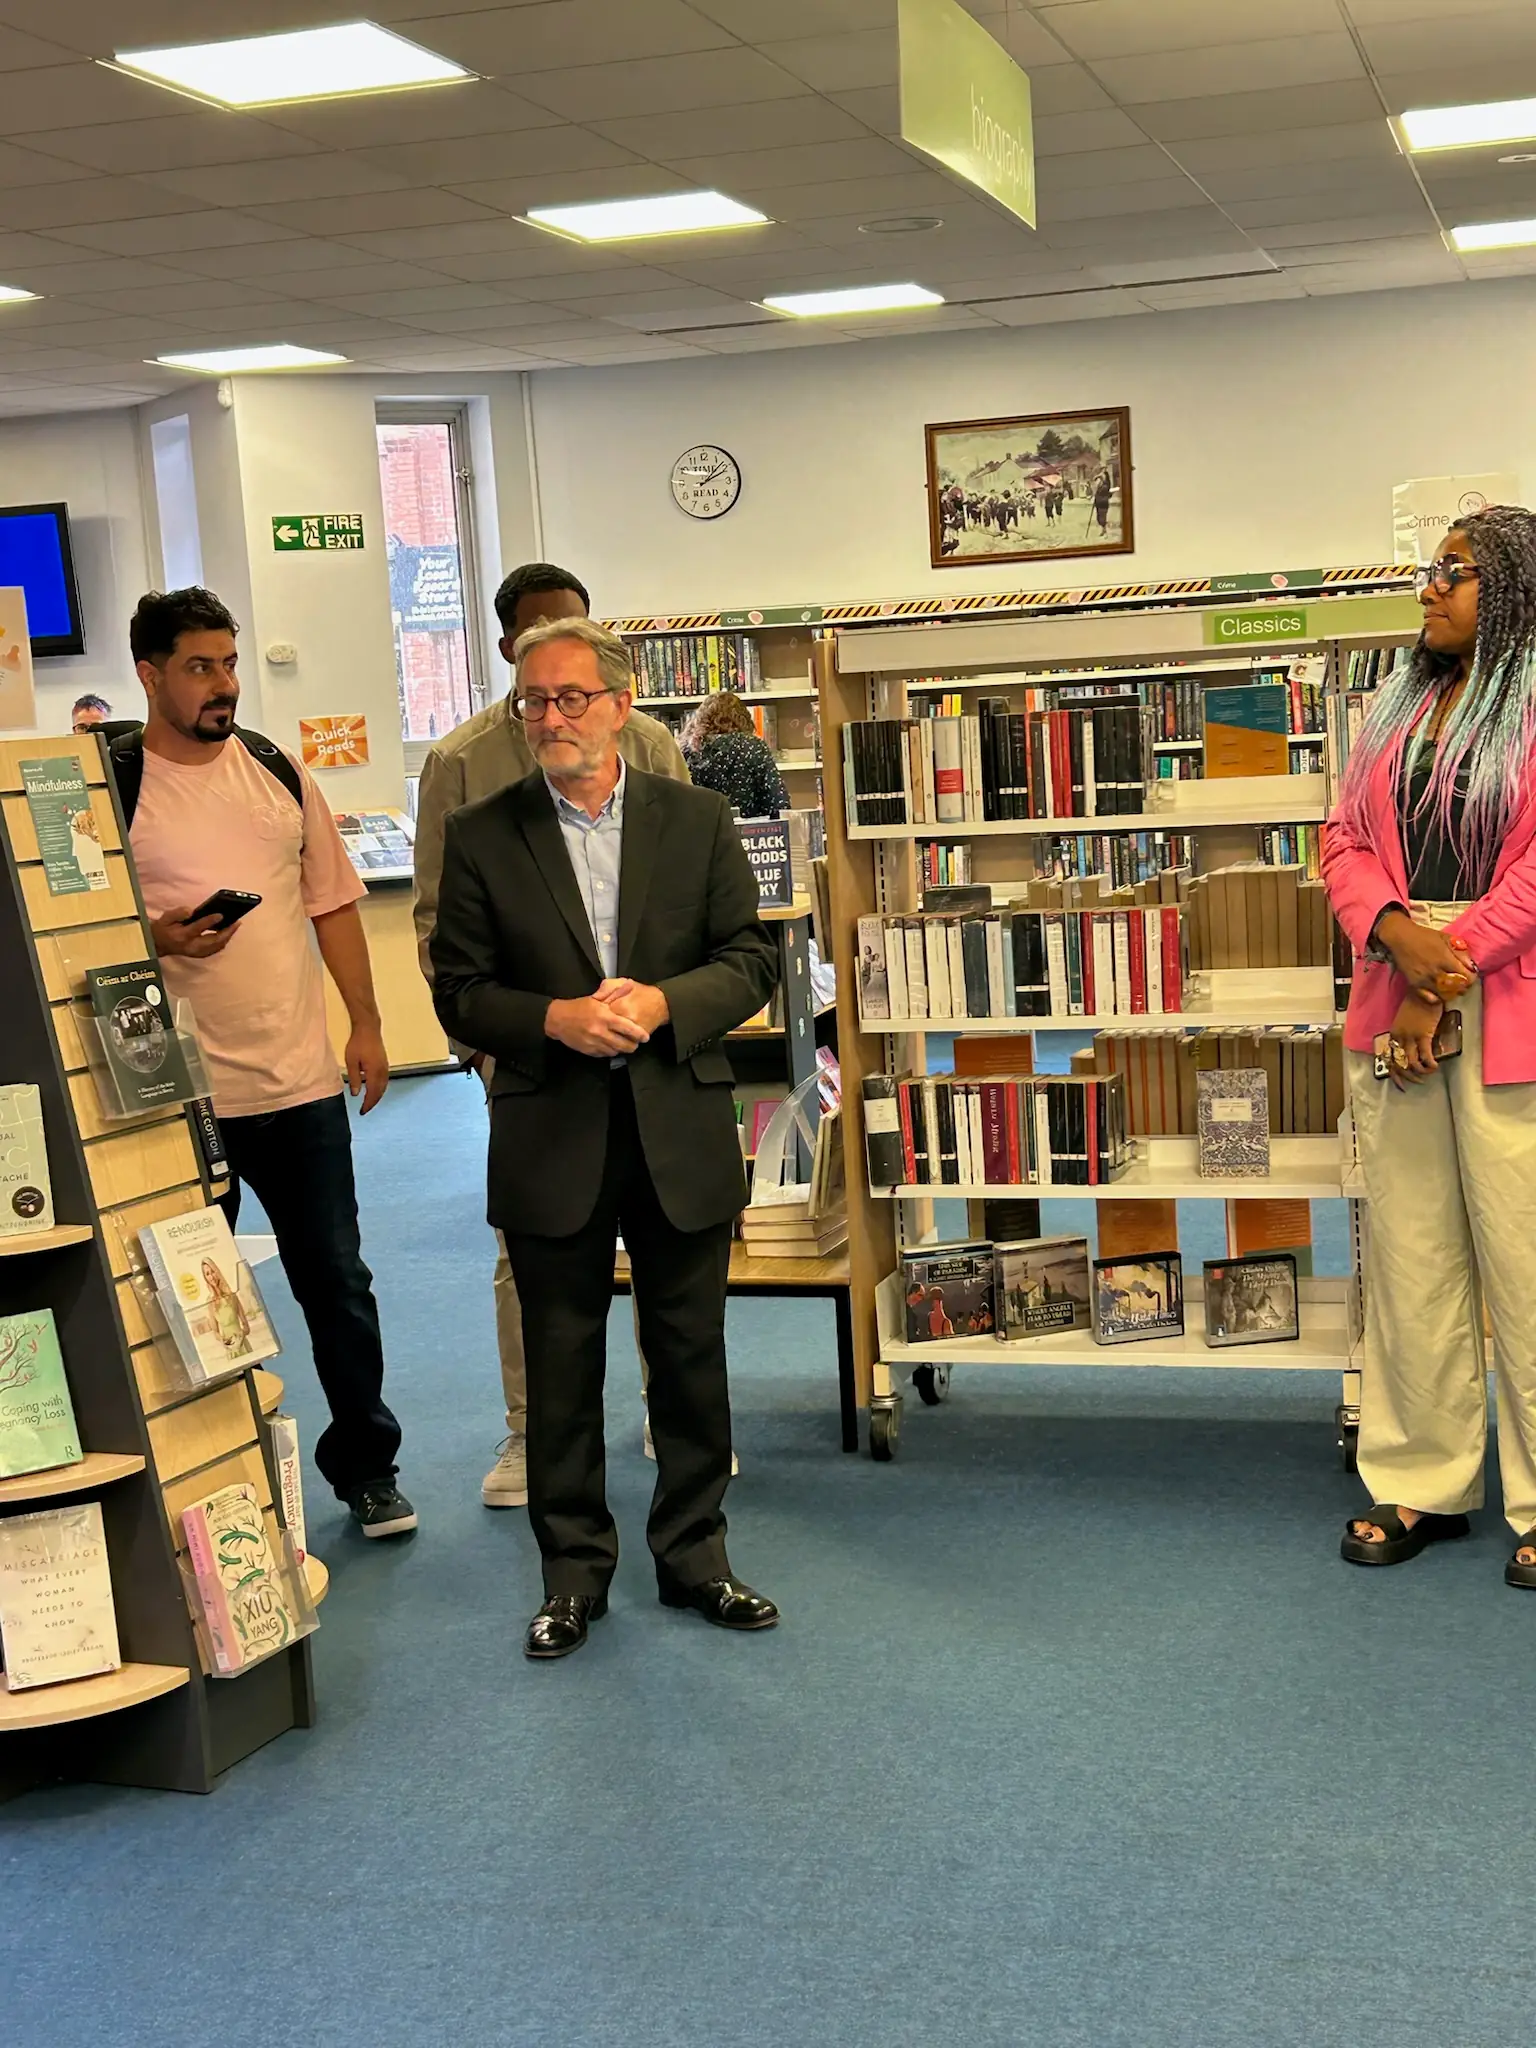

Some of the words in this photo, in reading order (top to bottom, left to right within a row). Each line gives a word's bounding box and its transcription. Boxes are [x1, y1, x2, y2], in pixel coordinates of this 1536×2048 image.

[700, 452, 708, 461] 12
[725, 476, 732, 485] 3
[693, 489, 719, 497] READ
[723, 490, 729, 498] 4
[692, 500, 698, 508] 7
[703, 503, 710, 512] 6
[715, 499, 721, 507] 5
[324, 516, 361, 530] FIRE
[1407, 515, 1450, 529] Crime
[325, 534, 361, 548] EXIT
[419, 557, 452, 570] Your
[417, 566, 455, 581] Local
[1220, 615, 1301, 636] Classics
[312, 723, 353, 743] Quick
[317, 740, 356, 757] Reads
[27, 778, 84, 793] Mindfulness
[741, 835, 785, 851] BLACK
[754, 868, 782, 882] LUE
[203, 1117, 220, 1156] COTTON
[2, 1402, 39, 1417] Coping
[42, 1394, 64, 1408] with
[44, 1409, 66, 1420] Loss
[284, 1460, 296, 1527] Pregnancy
[3, 1548, 99, 1572] MISCARRIAGE
[20, 1573, 49, 1585] WHAT
[55, 1569, 87, 1580] EVERY
[35, 1586, 75, 1598] WOMAN
[32, 1604, 64, 1616] NEEDS
[71, 1600, 84, 1610] TO
[243, 1593, 273, 1623] XIU
[44, 1618, 75, 1629] KNOW
[250, 1617, 278, 1640] YANG
